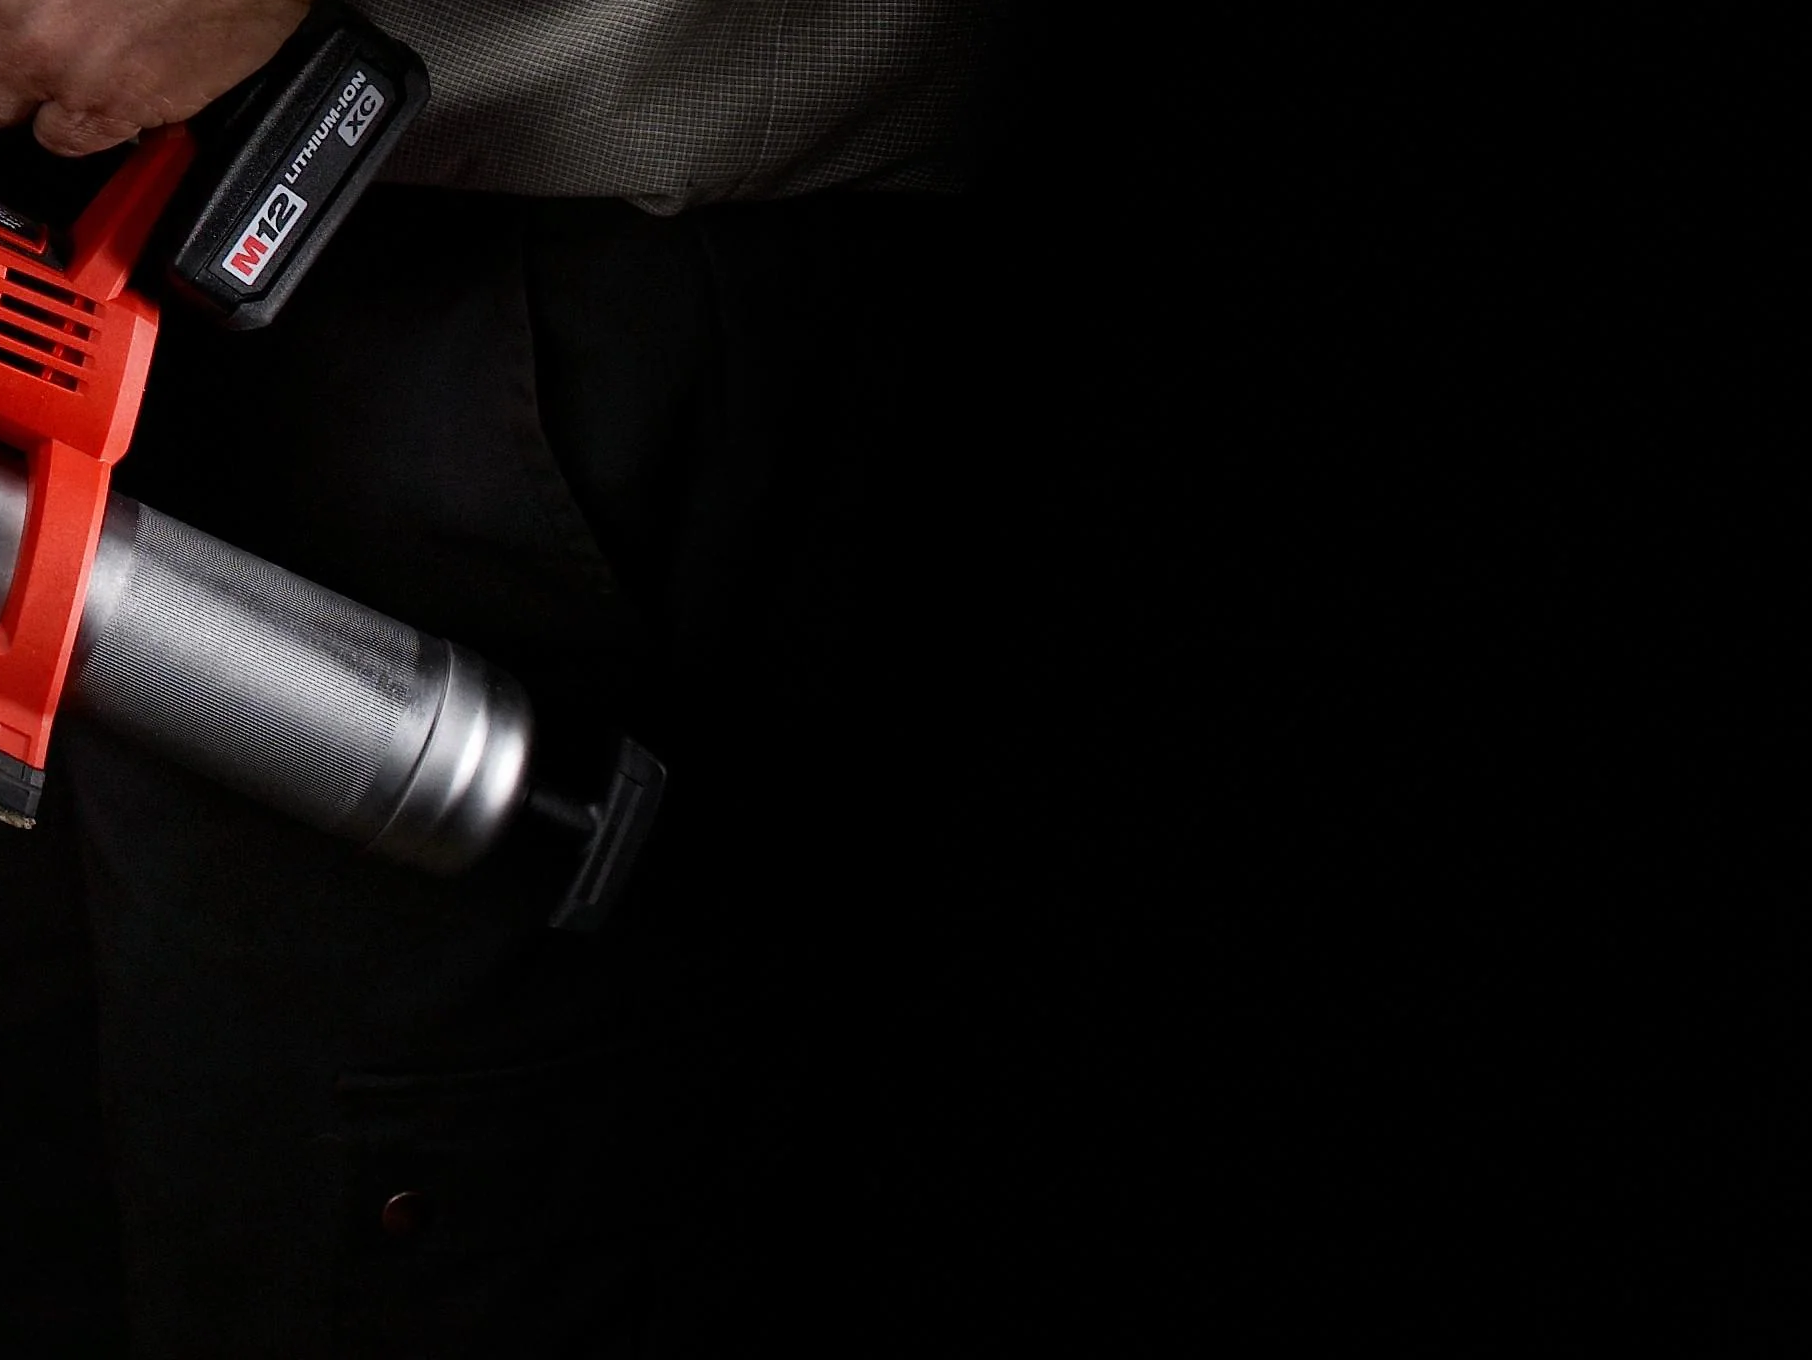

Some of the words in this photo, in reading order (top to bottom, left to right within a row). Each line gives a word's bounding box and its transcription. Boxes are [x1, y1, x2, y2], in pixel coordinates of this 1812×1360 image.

[284, 70, 367, 185] LITHIUM-ION
[345, 94, 377, 137] XC
[230, 192, 297, 277] M12
